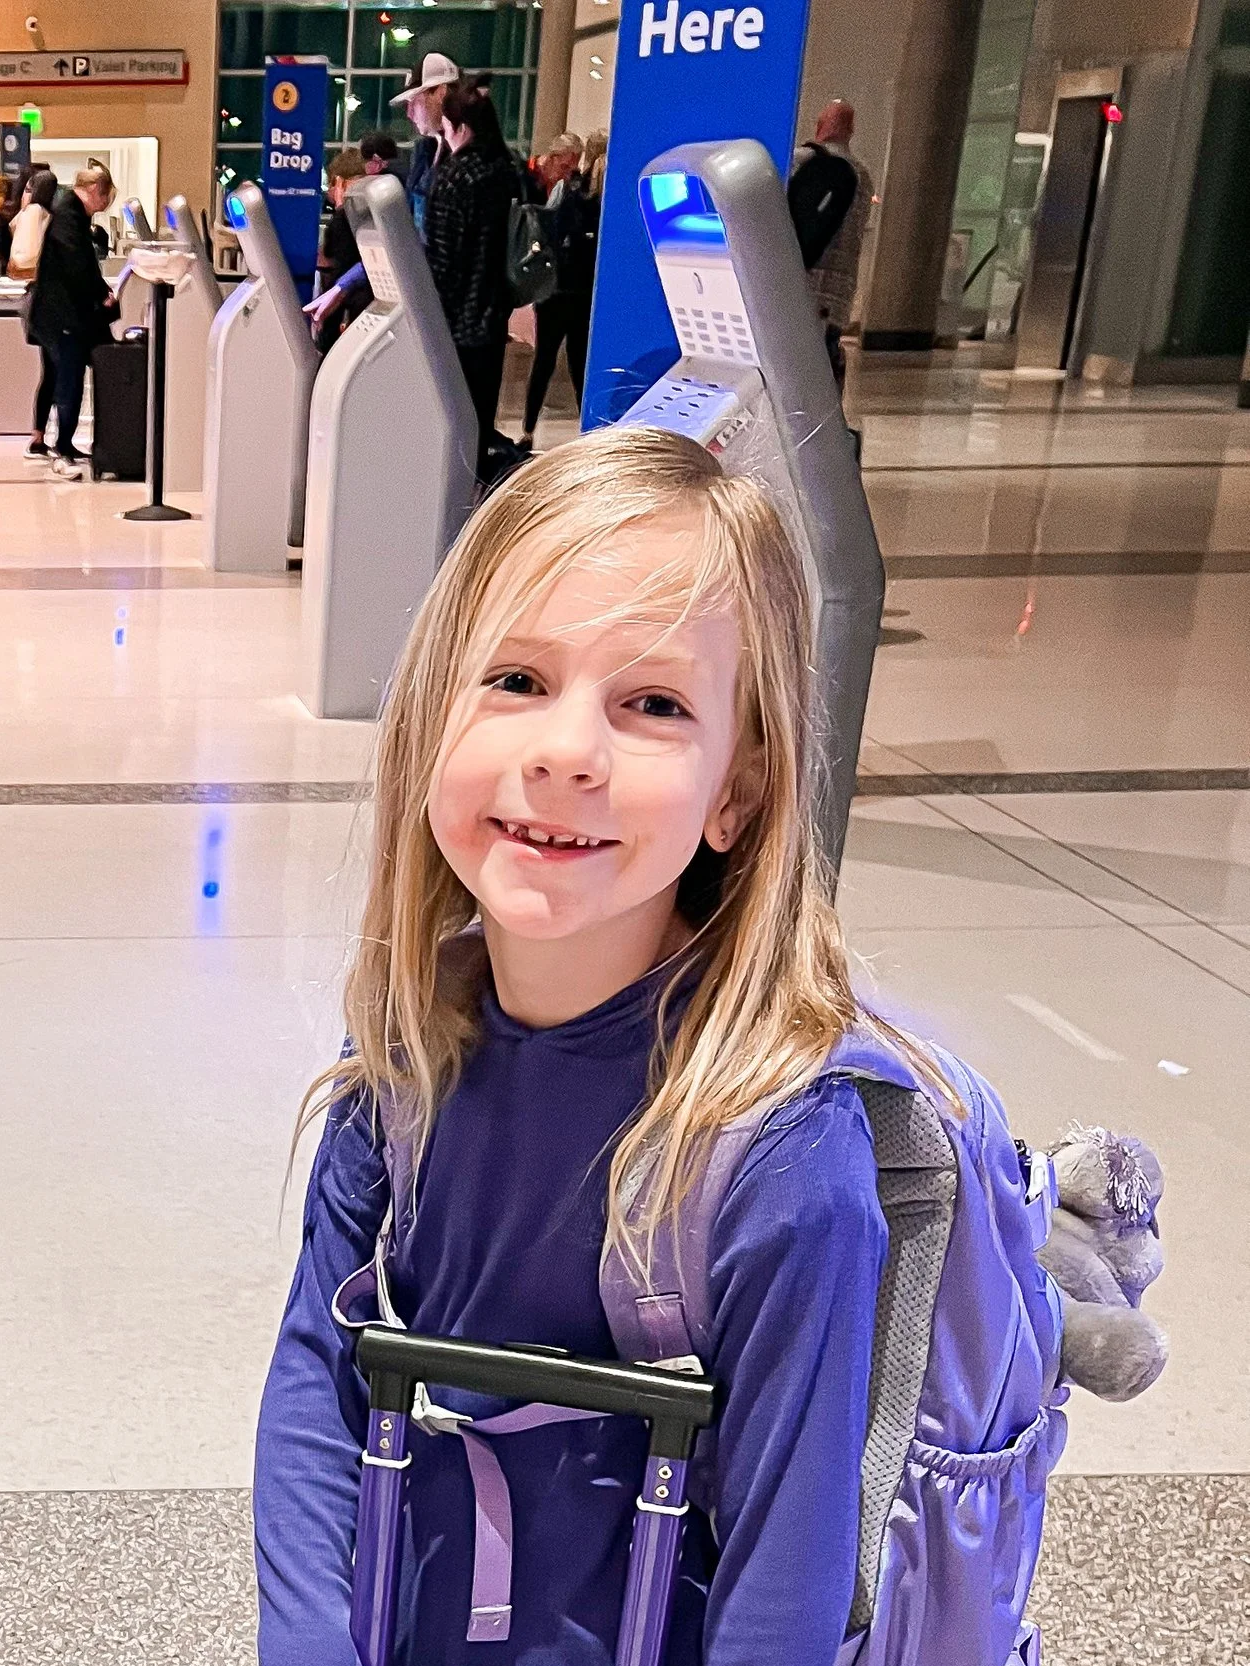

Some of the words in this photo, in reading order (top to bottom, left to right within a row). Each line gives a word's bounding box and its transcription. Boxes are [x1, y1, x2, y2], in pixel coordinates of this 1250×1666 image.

[639, 0, 764, 57] Here
[129, 60, 177, 74] Parking
[271, 128, 302, 151] Bag
[270, 152, 312, 172] Drop
